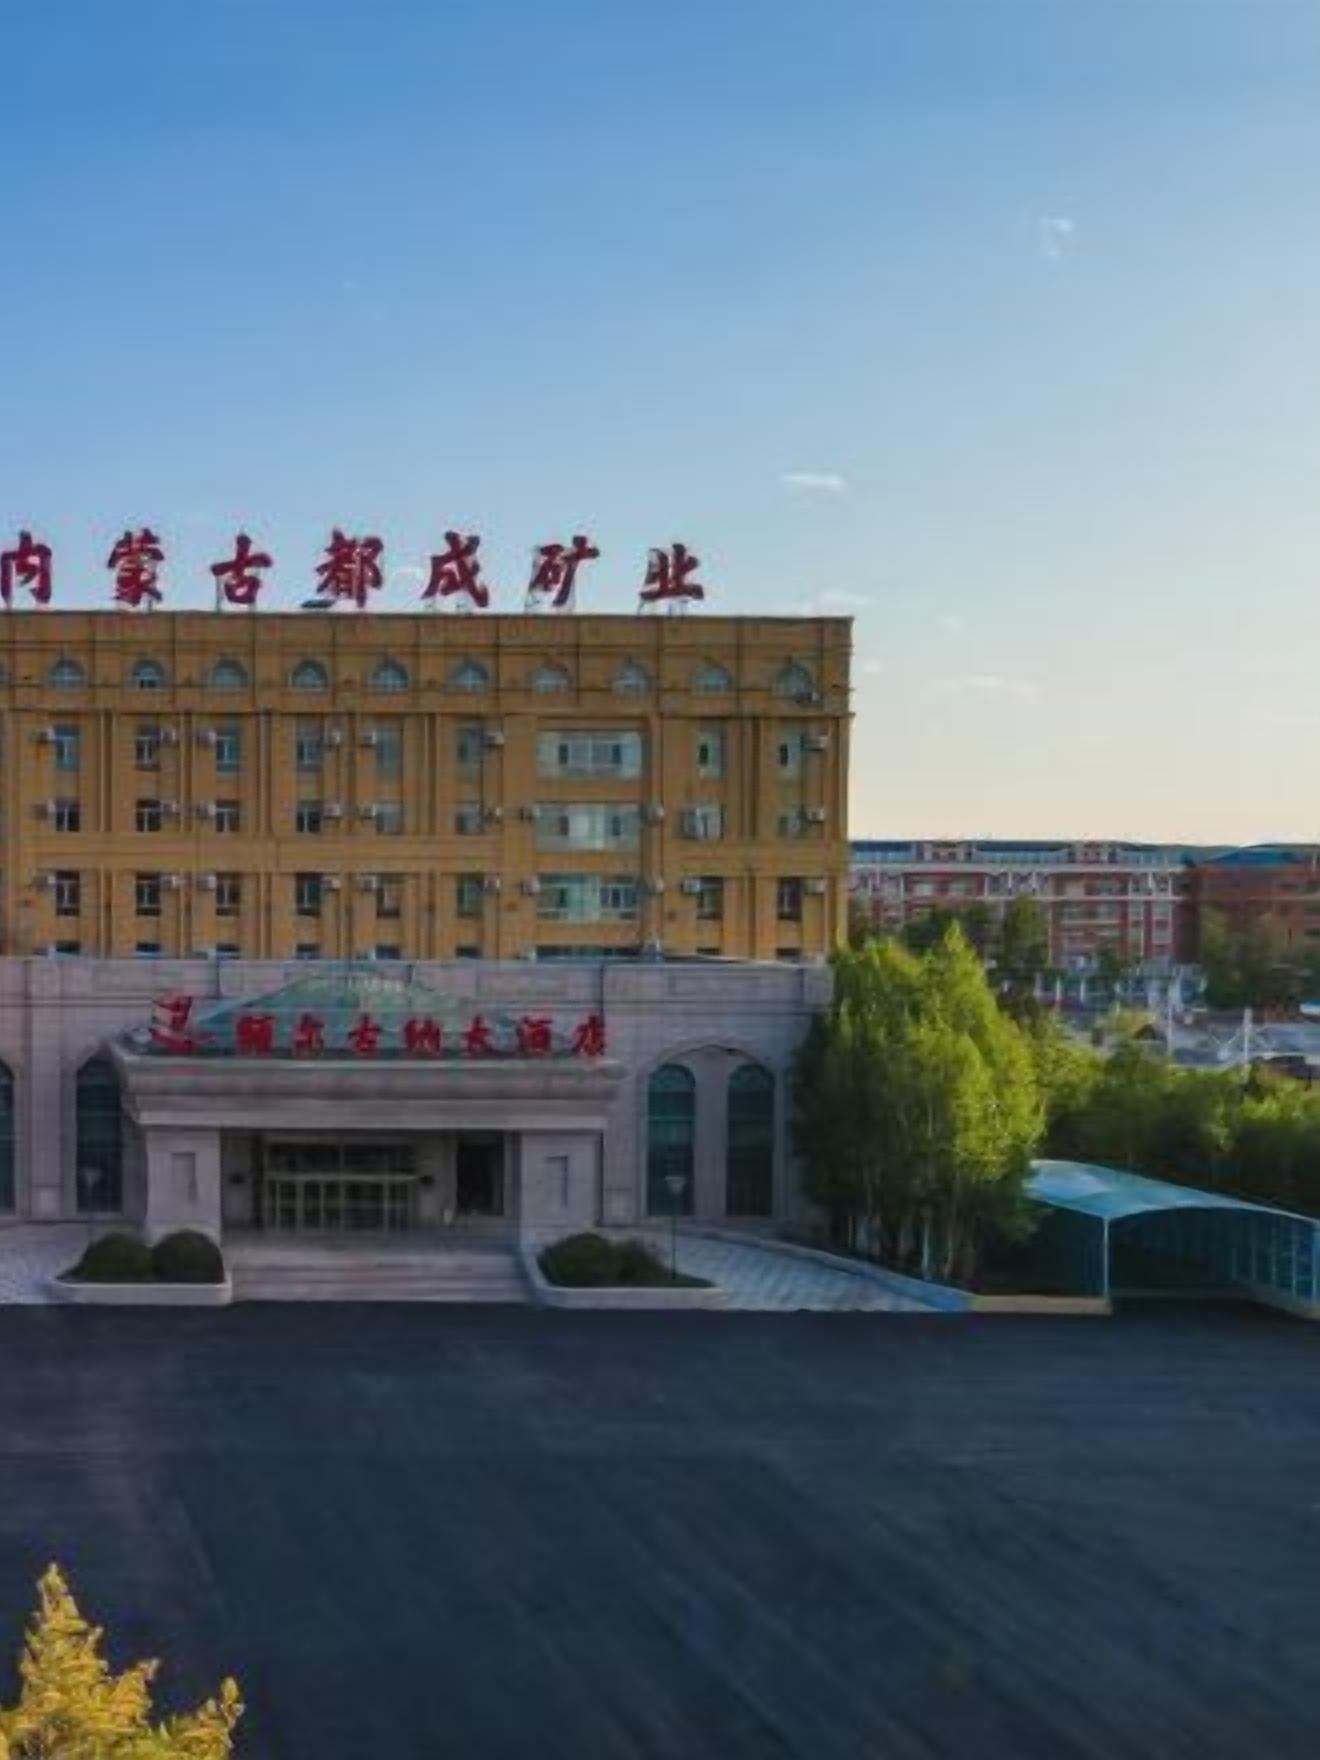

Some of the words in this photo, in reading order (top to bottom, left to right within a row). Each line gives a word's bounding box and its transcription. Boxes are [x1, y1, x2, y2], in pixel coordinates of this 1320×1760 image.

[0, 529, 703, 606] 内蒙古都成矿业
